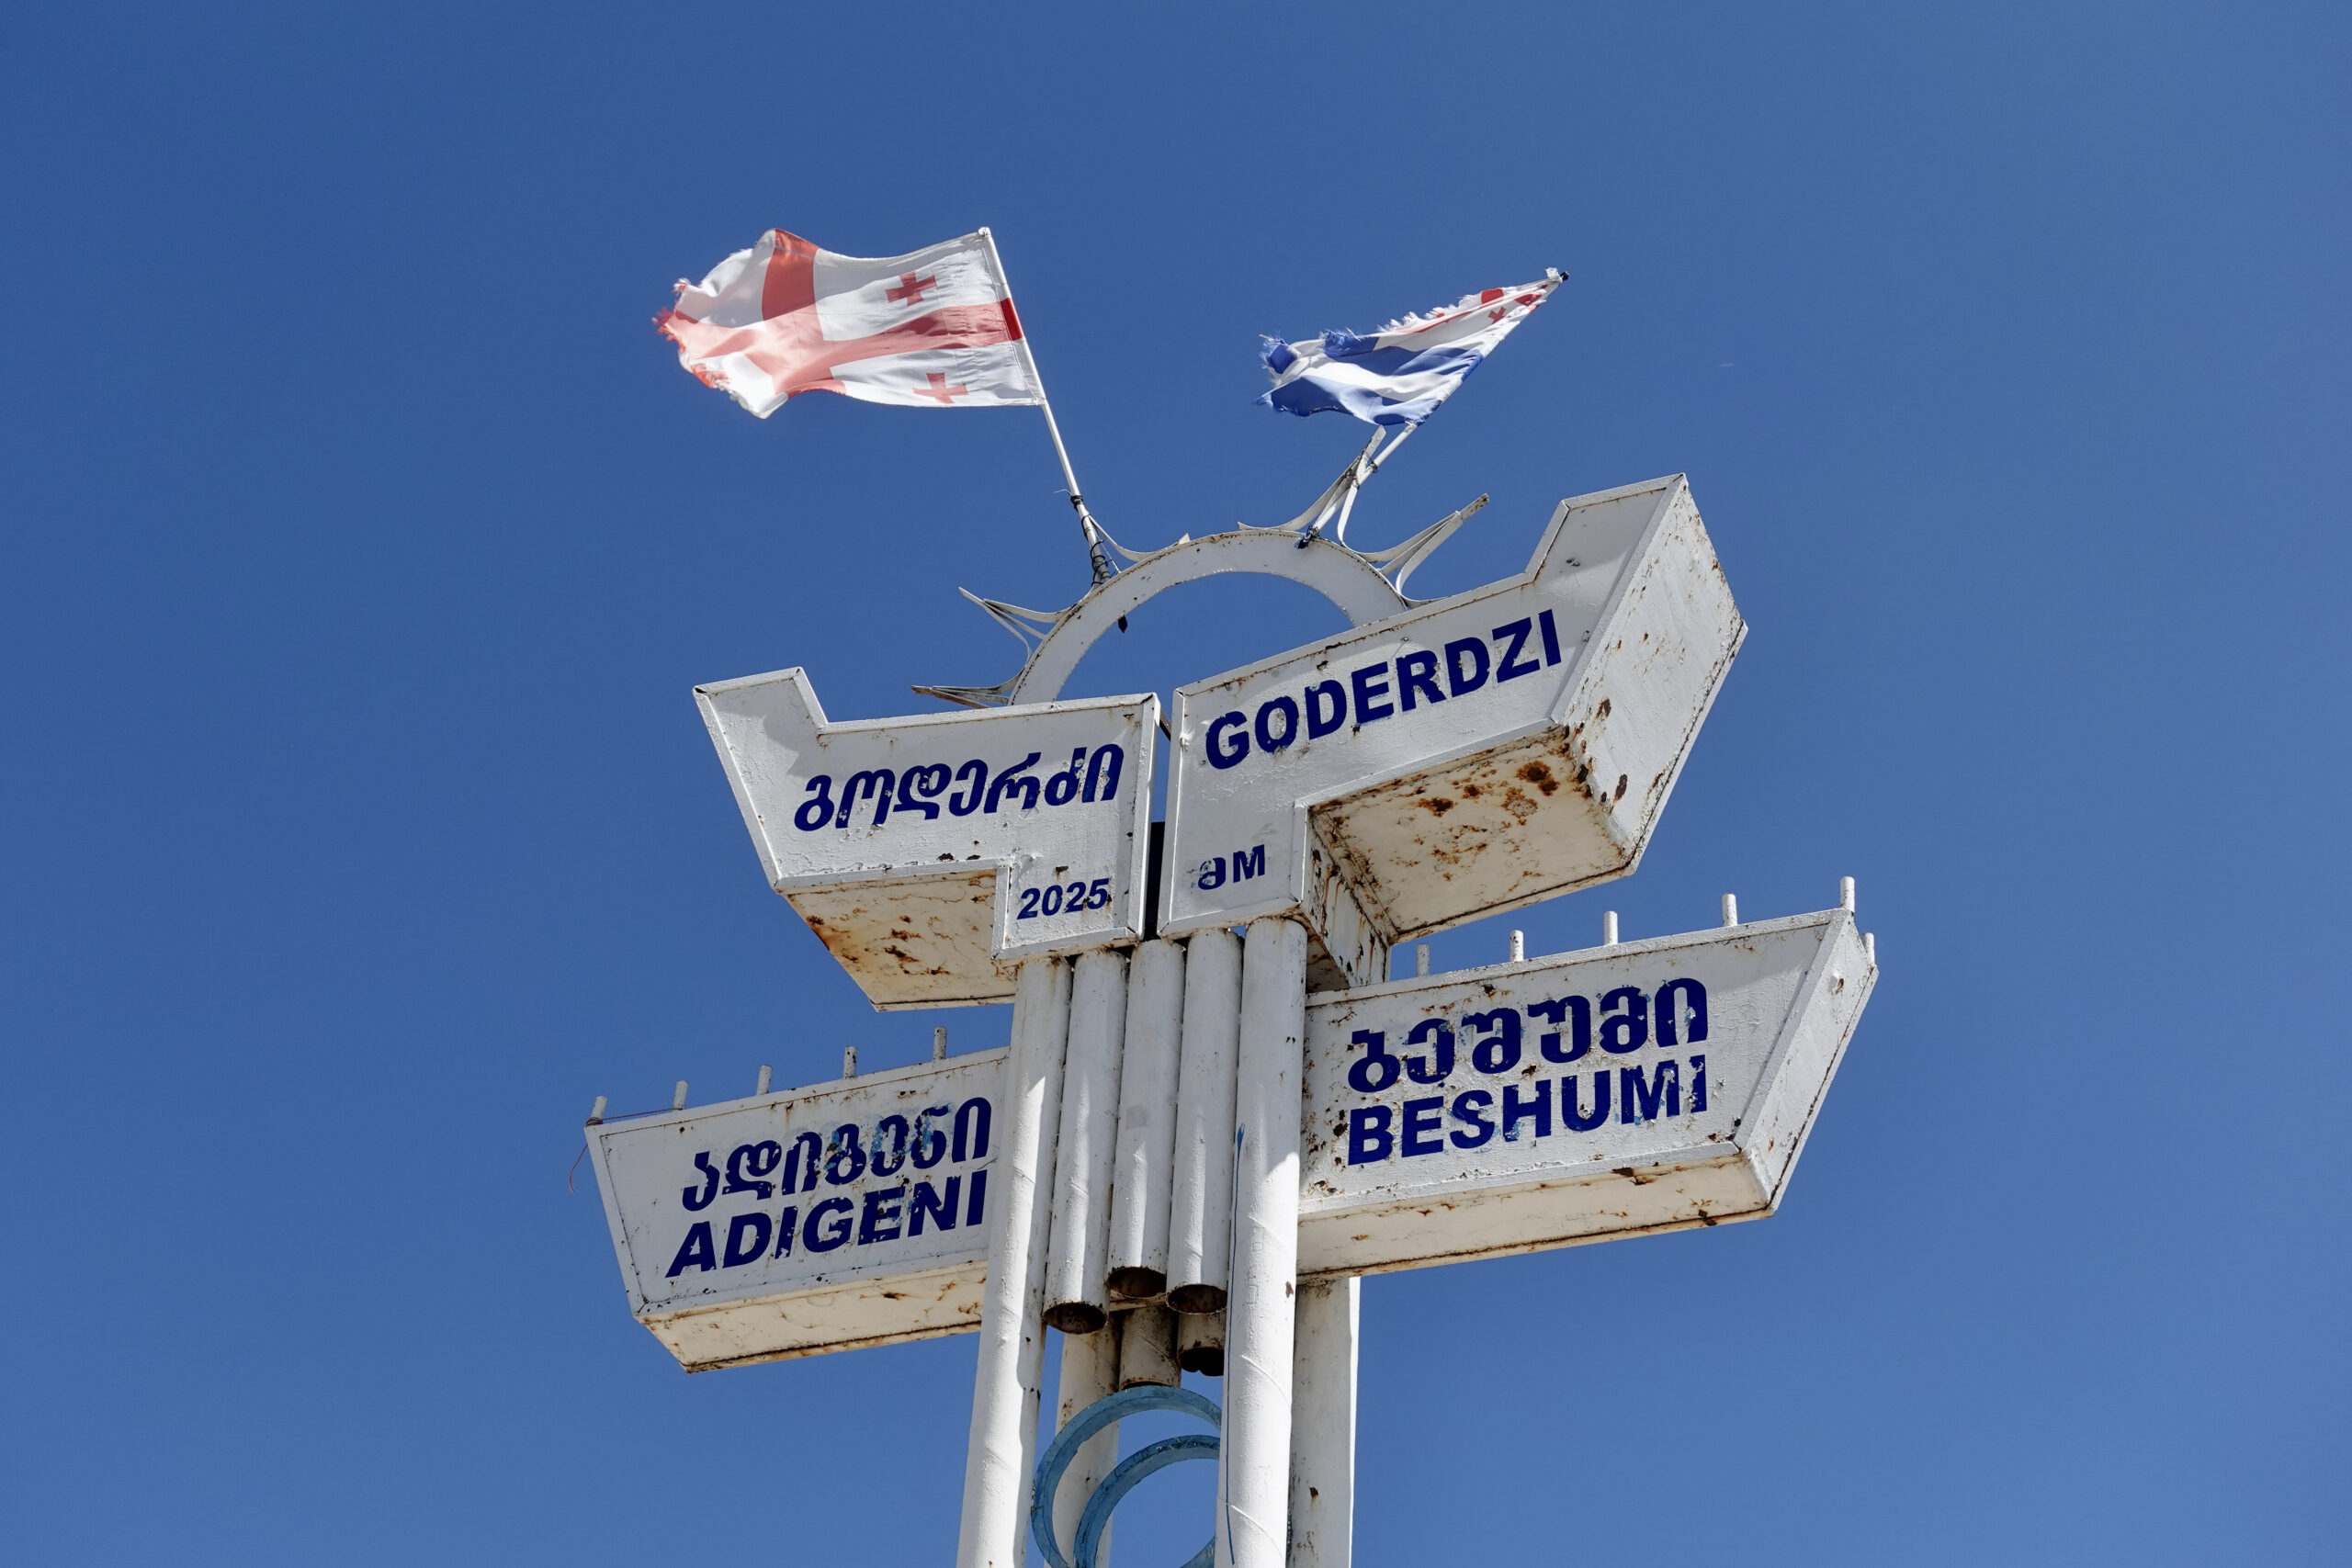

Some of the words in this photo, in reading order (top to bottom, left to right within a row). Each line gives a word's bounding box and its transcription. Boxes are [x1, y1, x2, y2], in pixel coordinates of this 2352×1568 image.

[1205, 609, 1562, 769] GODERDZI
[795, 743, 1125, 831] გოდერძი
[1017, 878, 1109, 919] 2025
[1349, 977, 1708, 1093] ბეშუმი
[683, 1097, 991, 1212] ადიგენი
[1348, 1055, 1707, 1166] BESHUMI
[665, 1169, 988, 1278] ADIGENI
